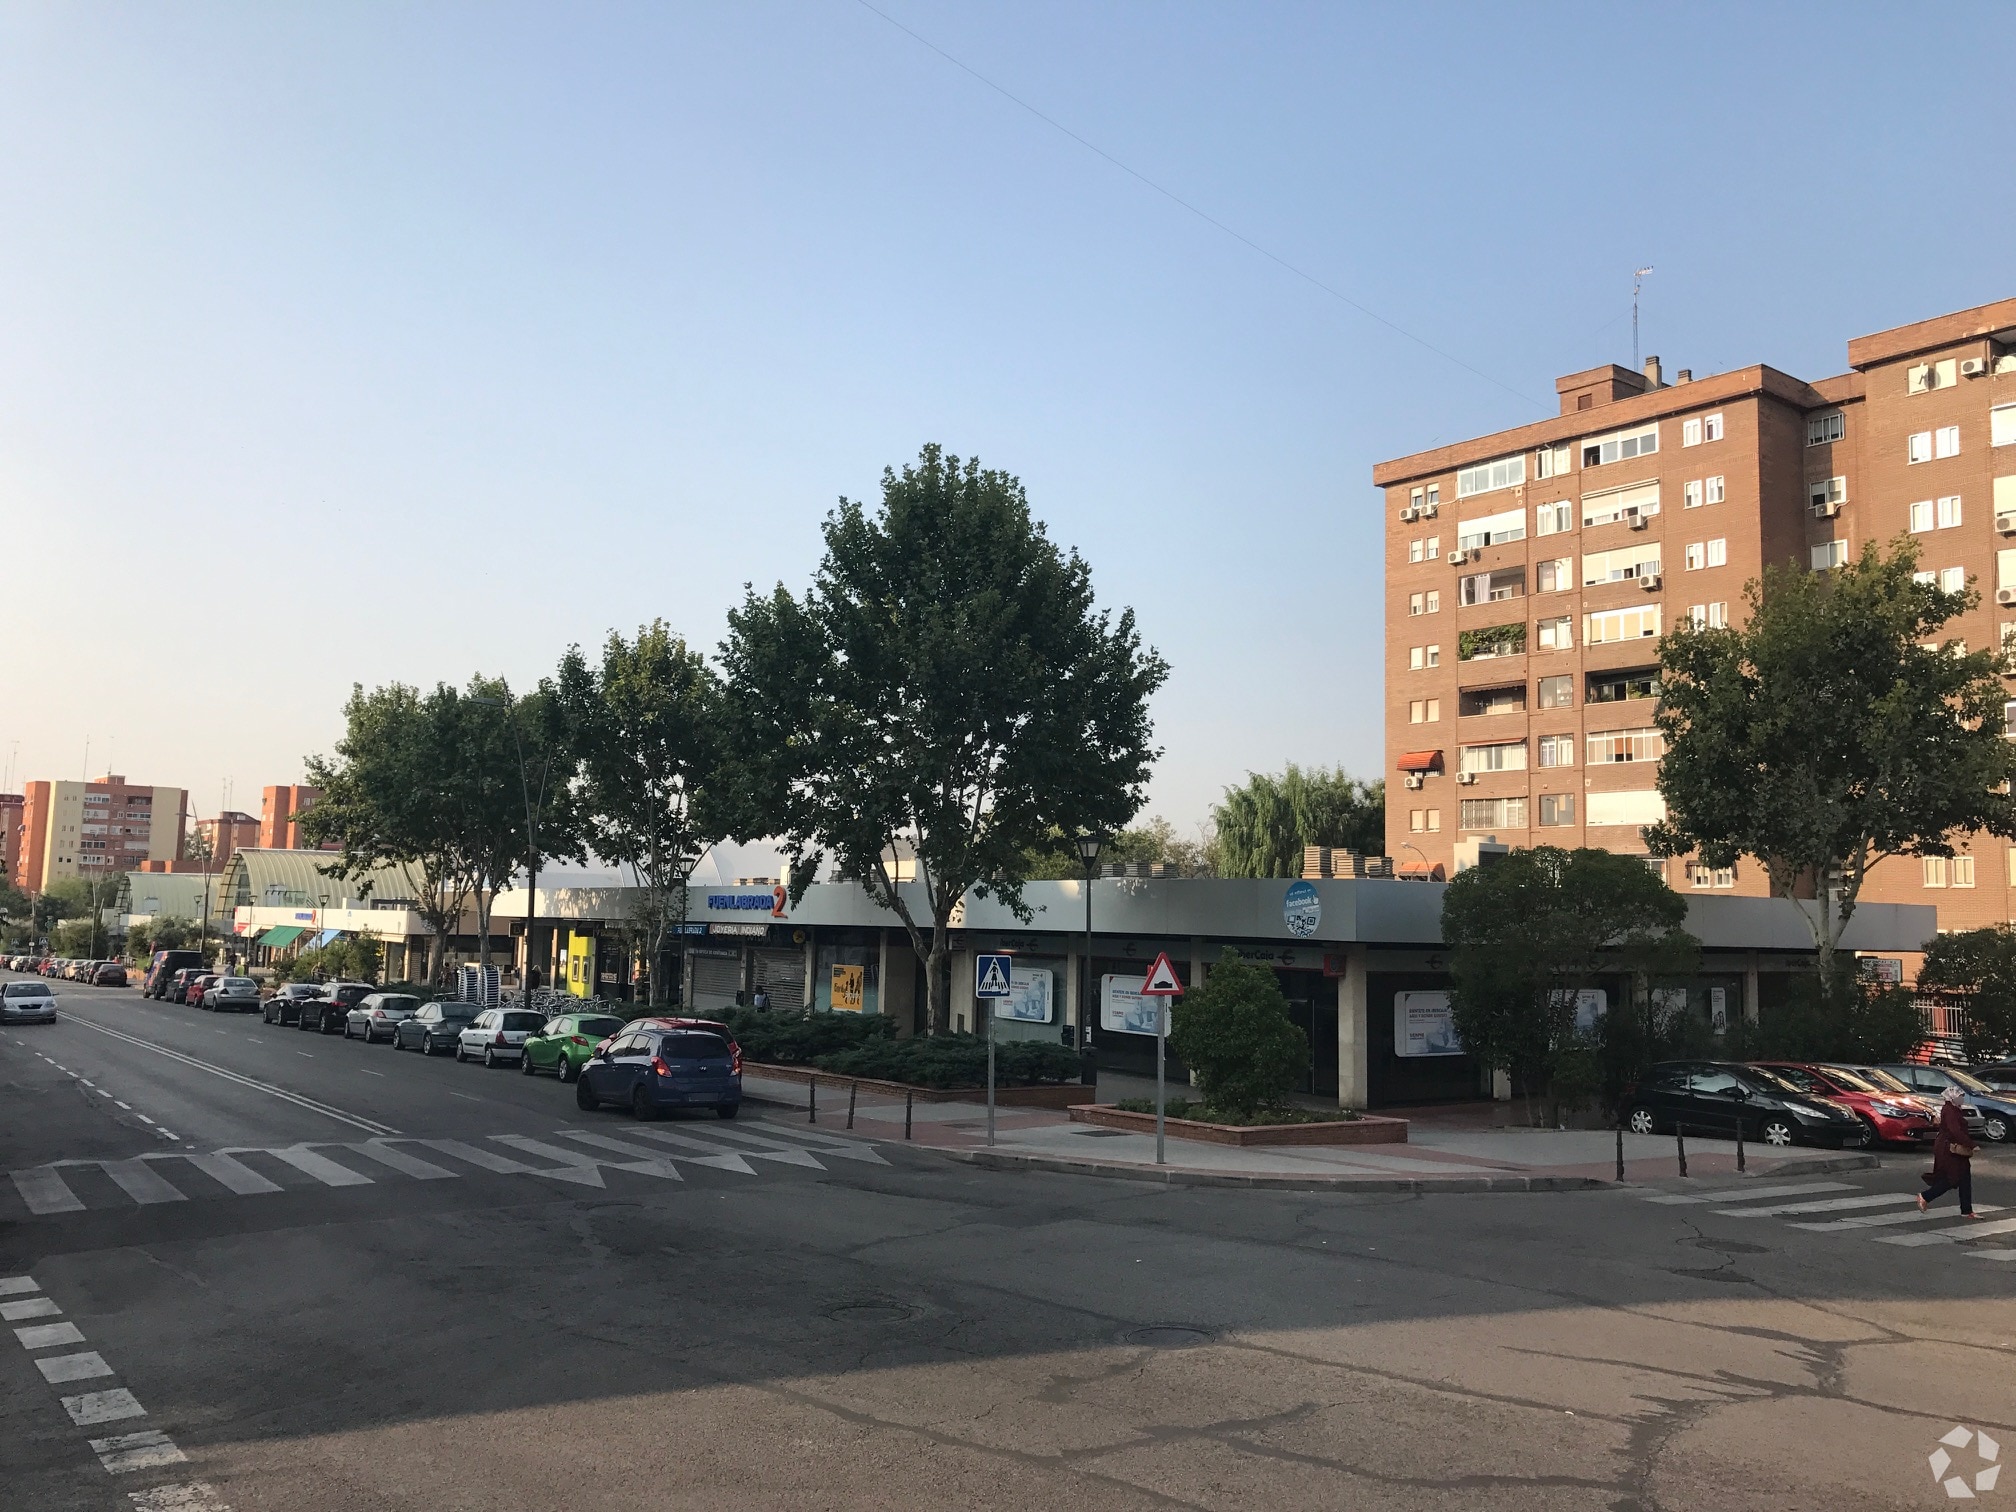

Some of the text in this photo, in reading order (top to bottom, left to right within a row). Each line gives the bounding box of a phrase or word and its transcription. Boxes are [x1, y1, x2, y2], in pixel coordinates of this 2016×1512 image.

[708, 885, 788, 919] FUENLABRADA 2
[1286, 896, 1312, 908] facebook
[712, 925, 765, 937] JOYERIA INDIANO
